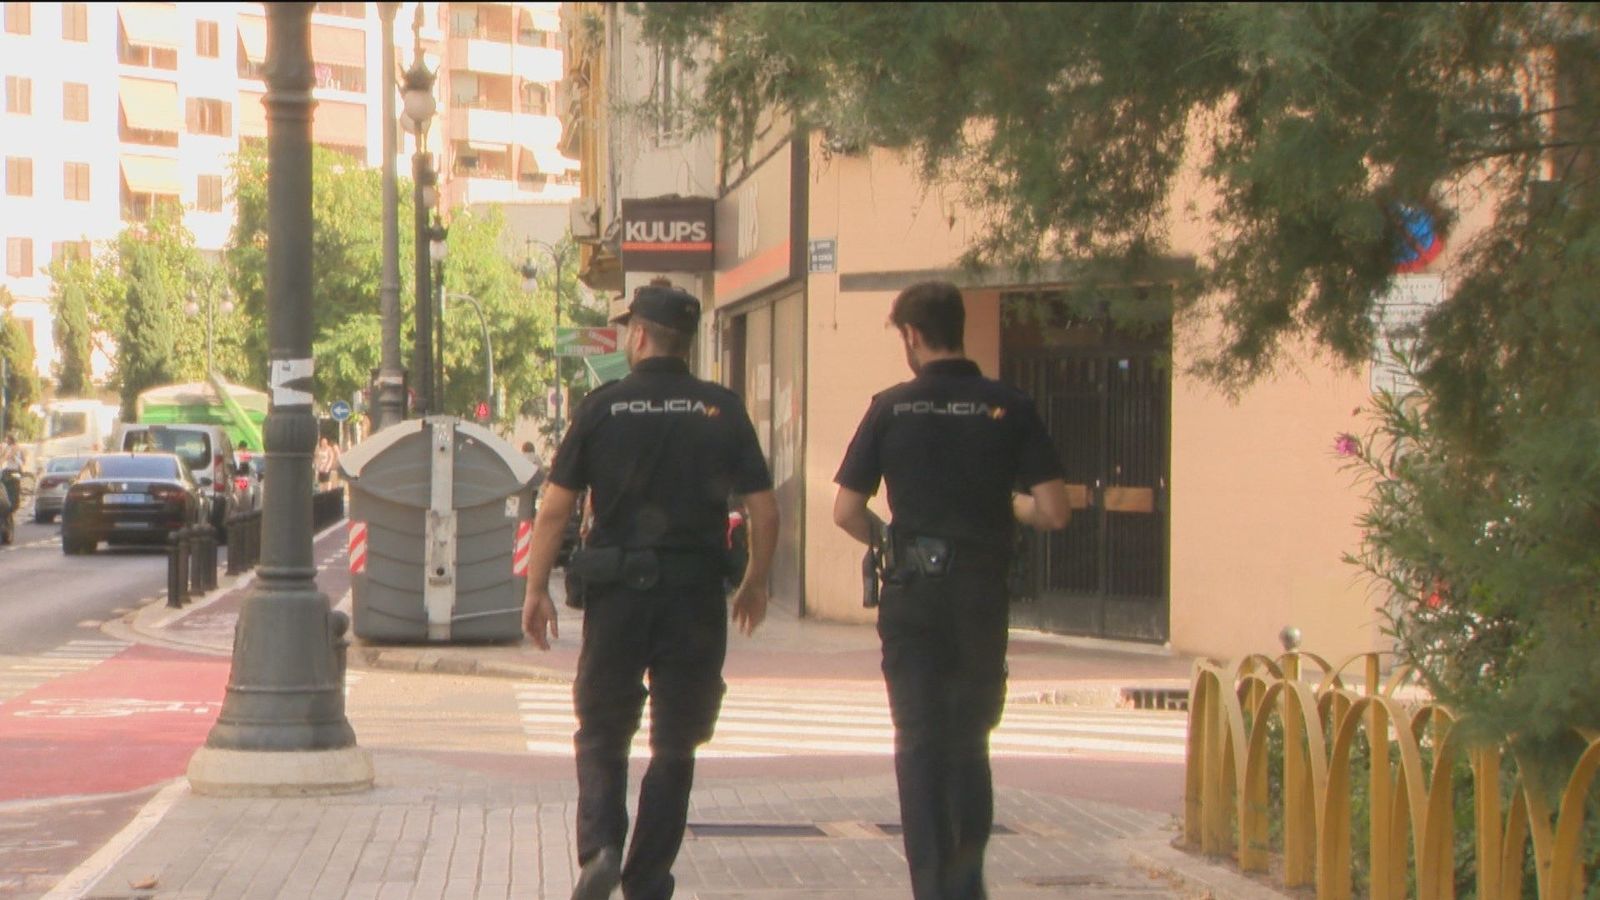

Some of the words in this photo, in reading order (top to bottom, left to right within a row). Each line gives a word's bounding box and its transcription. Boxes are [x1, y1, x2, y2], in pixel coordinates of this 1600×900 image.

[625, 220, 707, 242] KUUPS
[611, 400, 707, 416] POLICIA
[893, 401, 991, 416] POLICIA
